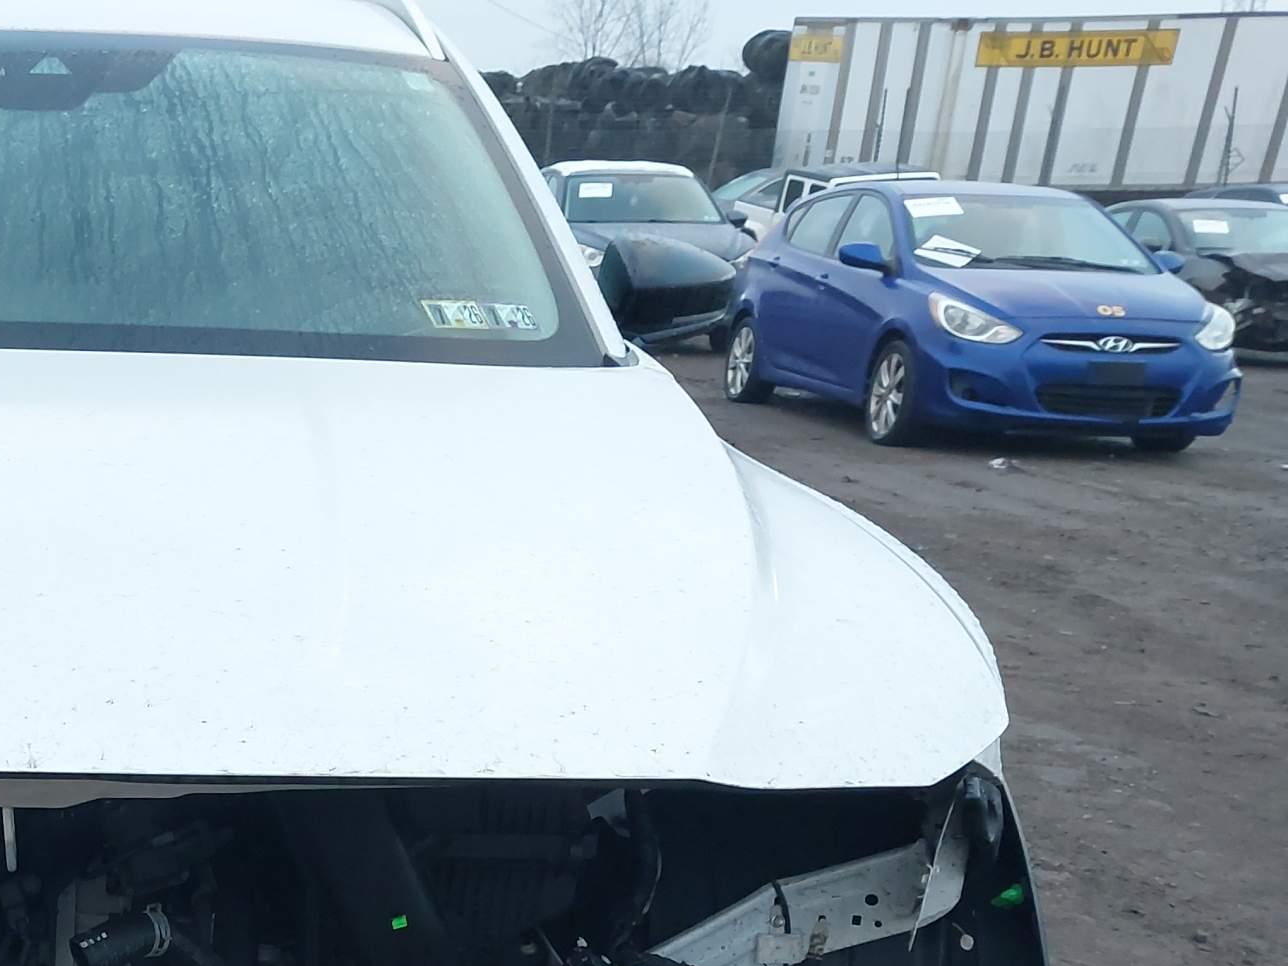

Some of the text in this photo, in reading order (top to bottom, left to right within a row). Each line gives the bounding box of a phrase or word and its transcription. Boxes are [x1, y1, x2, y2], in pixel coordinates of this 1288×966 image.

[1015, 38, 1138, 59] J.B. HUNT
[463, 304, 484, 325] 26
